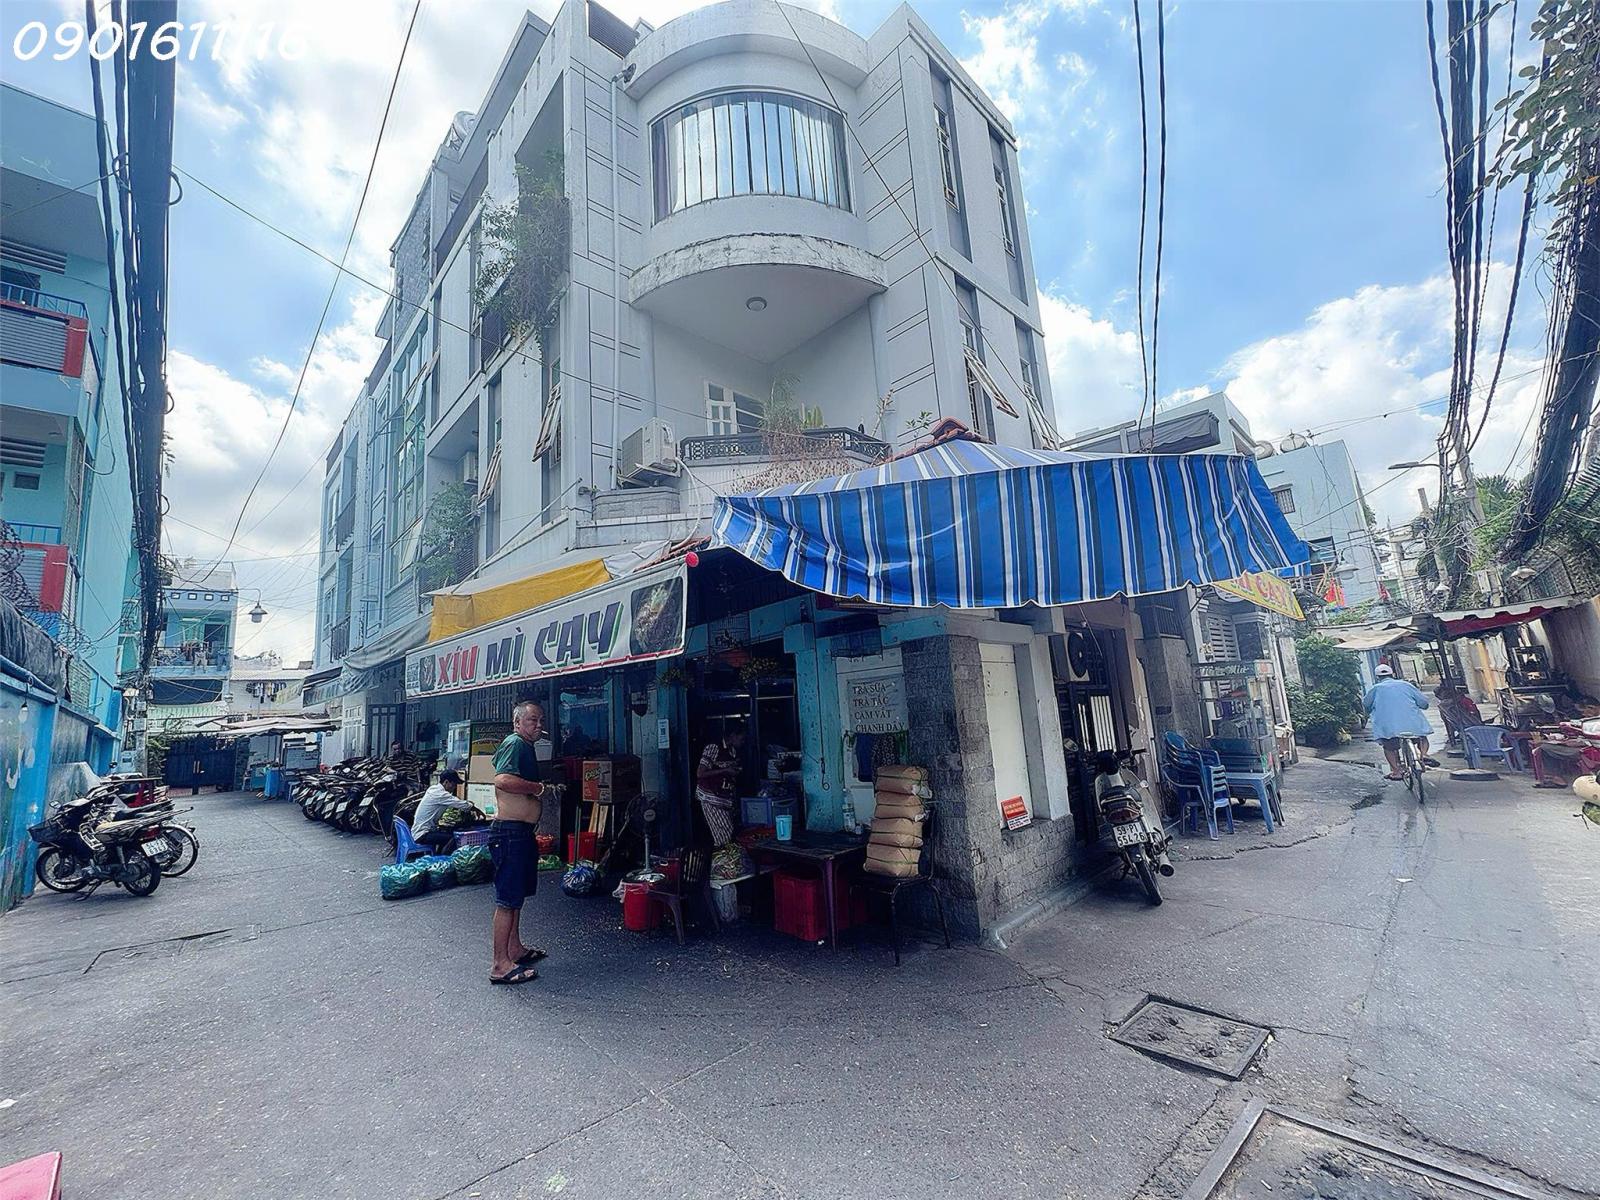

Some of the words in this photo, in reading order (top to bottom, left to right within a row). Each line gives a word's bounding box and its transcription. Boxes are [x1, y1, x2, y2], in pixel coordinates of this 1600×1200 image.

[485, 627, 525, 678] MÌ
[533, 601, 624, 670] CAY
[1116, 823, 1139, 836] 59-P1
